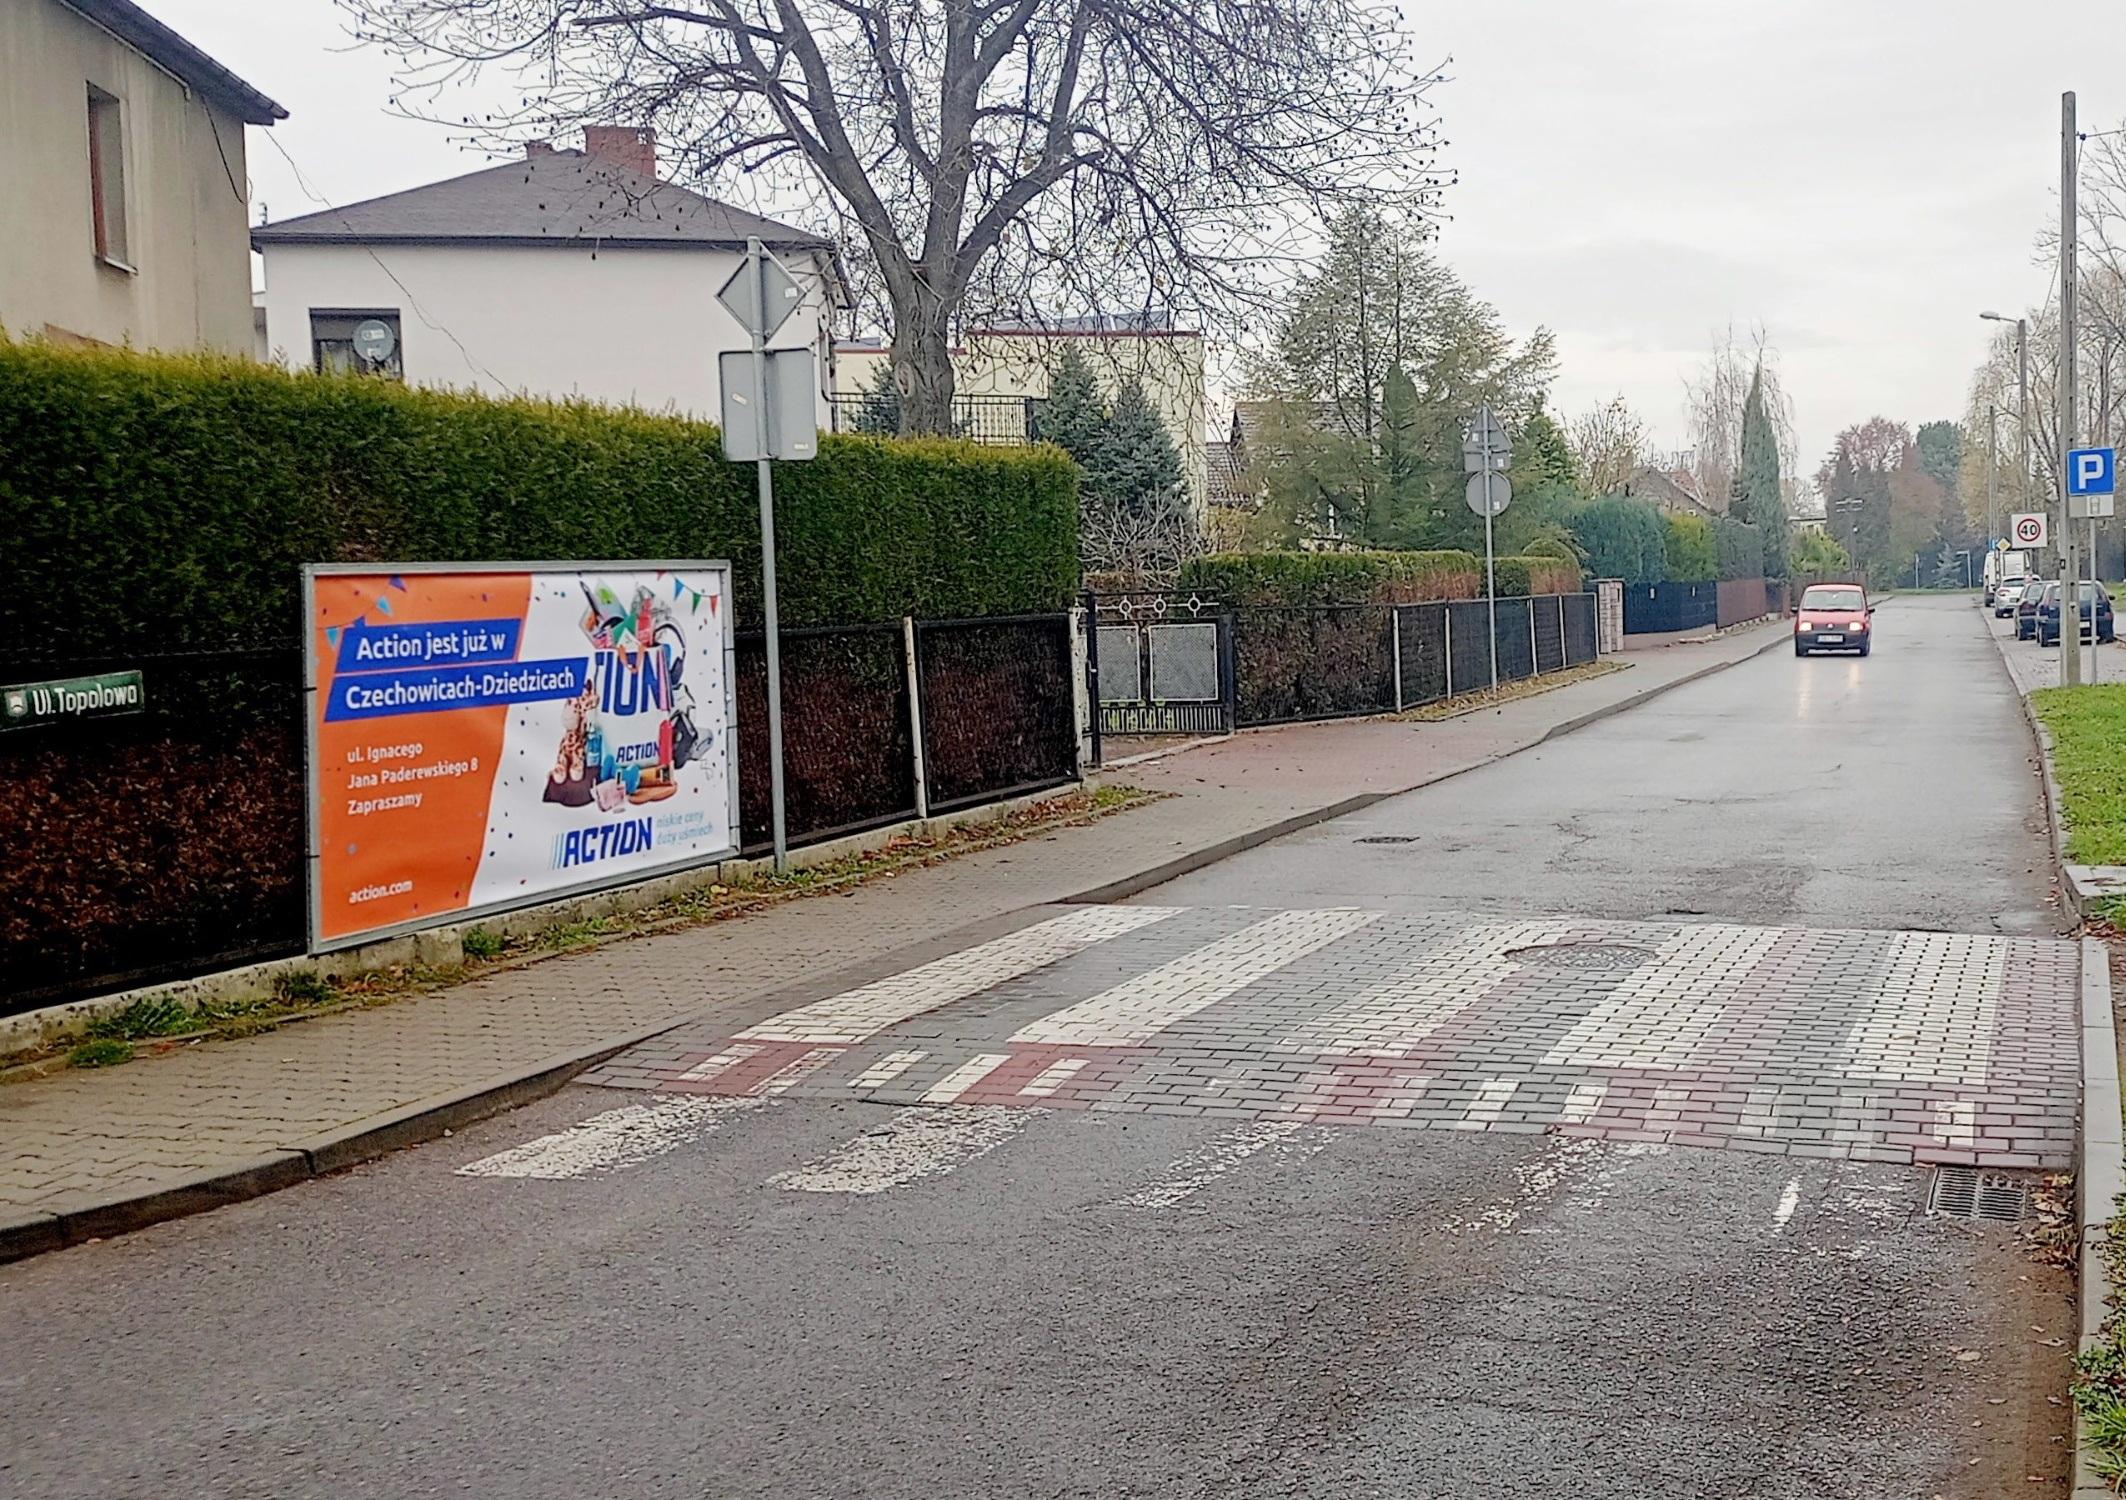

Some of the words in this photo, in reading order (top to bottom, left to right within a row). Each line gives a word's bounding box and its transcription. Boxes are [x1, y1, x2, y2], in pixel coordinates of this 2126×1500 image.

[2078, 454, 2104, 489] P
[2020, 524, 2038, 536] 40
[356, 633, 422, 660] Action
[424, 630, 459, 660] jest
[461, 628, 488, 658] już
[491, 633, 506, 650] w
[54, 683, 138, 715] Topolowa
[346, 666, 574, 709] Czechowicach-Dziedzicach
[347, 746, 364, 763] ul.
[367, 742, 423, 763] Ignacego
[347, 774, 378, 789] Jana
[380, 759, 468, 784] Paderewskiego
[470, 757, 479, 771] 8
[347, 792, 423, 816] Zapraszamy
[562, 816, 652, 868] ACTION
[348, 880, 413, 904] action.com
